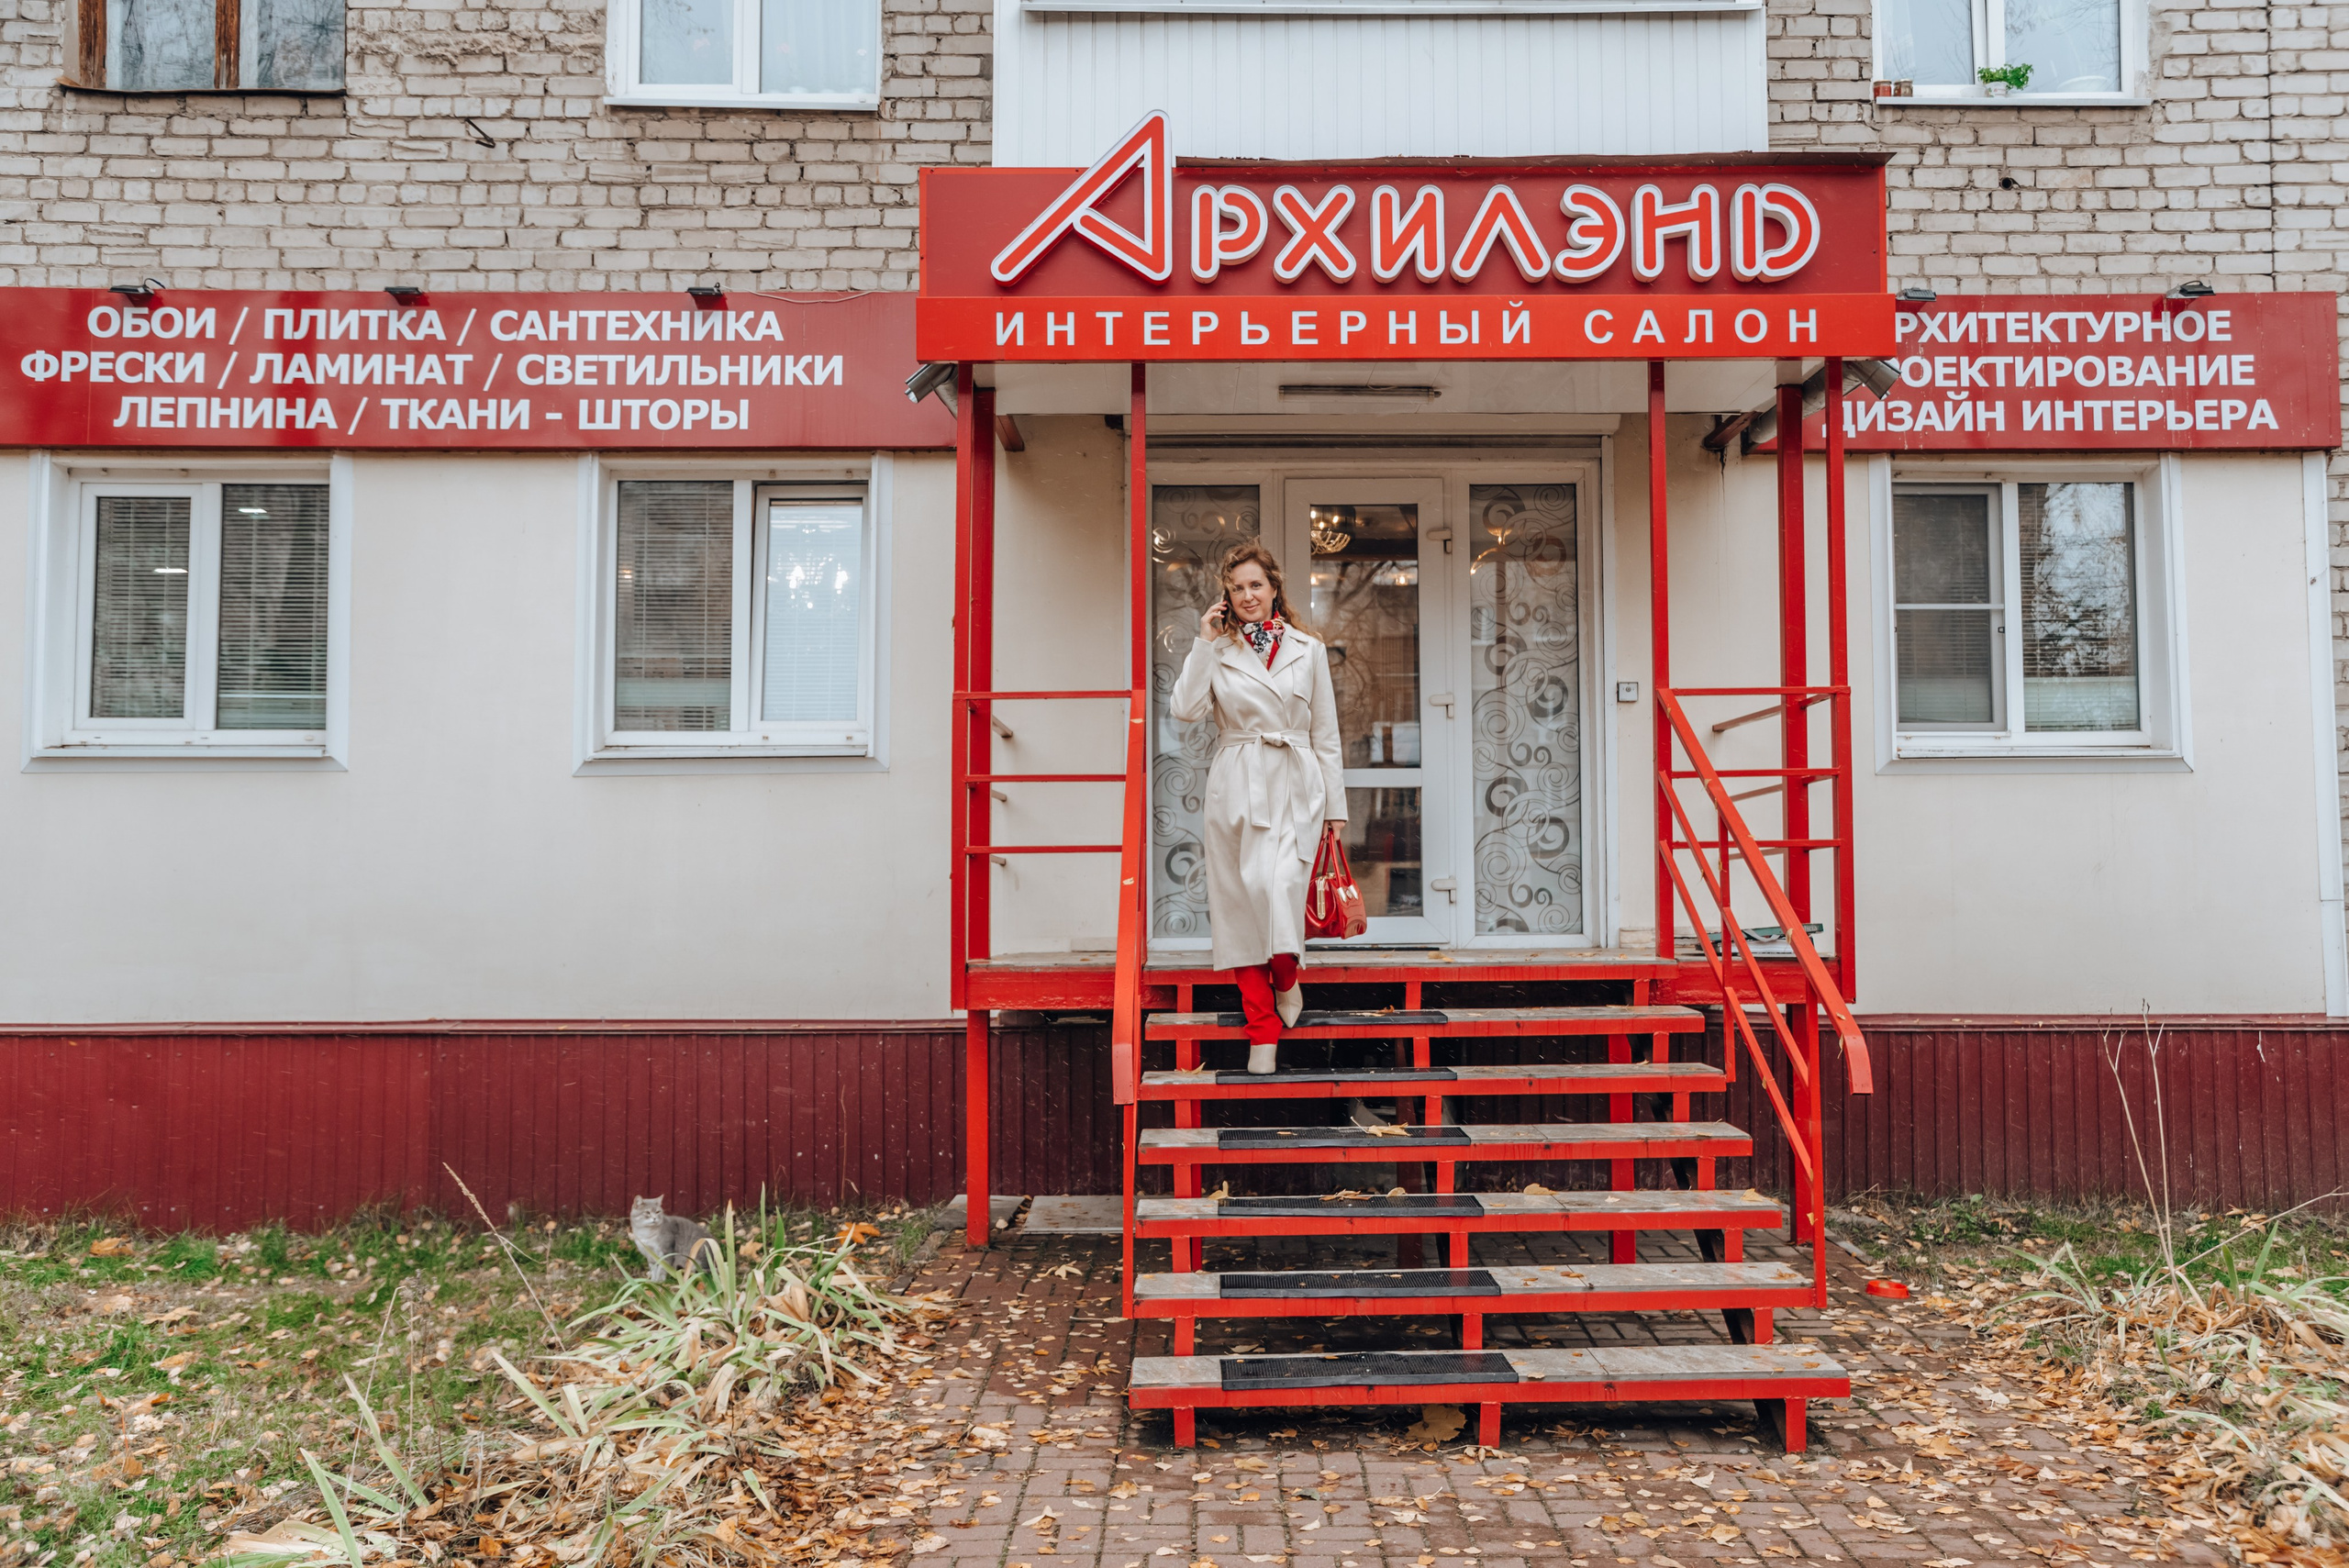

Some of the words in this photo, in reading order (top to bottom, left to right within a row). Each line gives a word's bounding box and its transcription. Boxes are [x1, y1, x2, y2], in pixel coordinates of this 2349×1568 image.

[87, 306, 217, 339] ОБОИ
[263, 308, 447, 340] ПЛИТКА
[490, 309, 785, 342] САНТЕХНИКА
[996, 300, 1531, 347] ИНТЕРЬЕРНЫЙ
[1584, 308, 1818, 344] САЛОН
[1895, 309, 2232, 343] РХИТЕКТУРНОЕ
[20, 350, 206, 384] ФРЕСКИ
[249, 353, 474, 385] ЛАМИНАТ
[517, 353, 843, 386] СВЕТИЛЬНИКИ
[1883, 354, 2255, 388] ОЕКТИРОВАНИЕ
[113, 395, 339, 429] ЛЕПНИНА
[380, 397, 530, 430] ТКАНИ
[578, 397, 750, 431] ШТОРЫ
[2021, 398, 2279, 432] ИНТЕРЬЕРА
